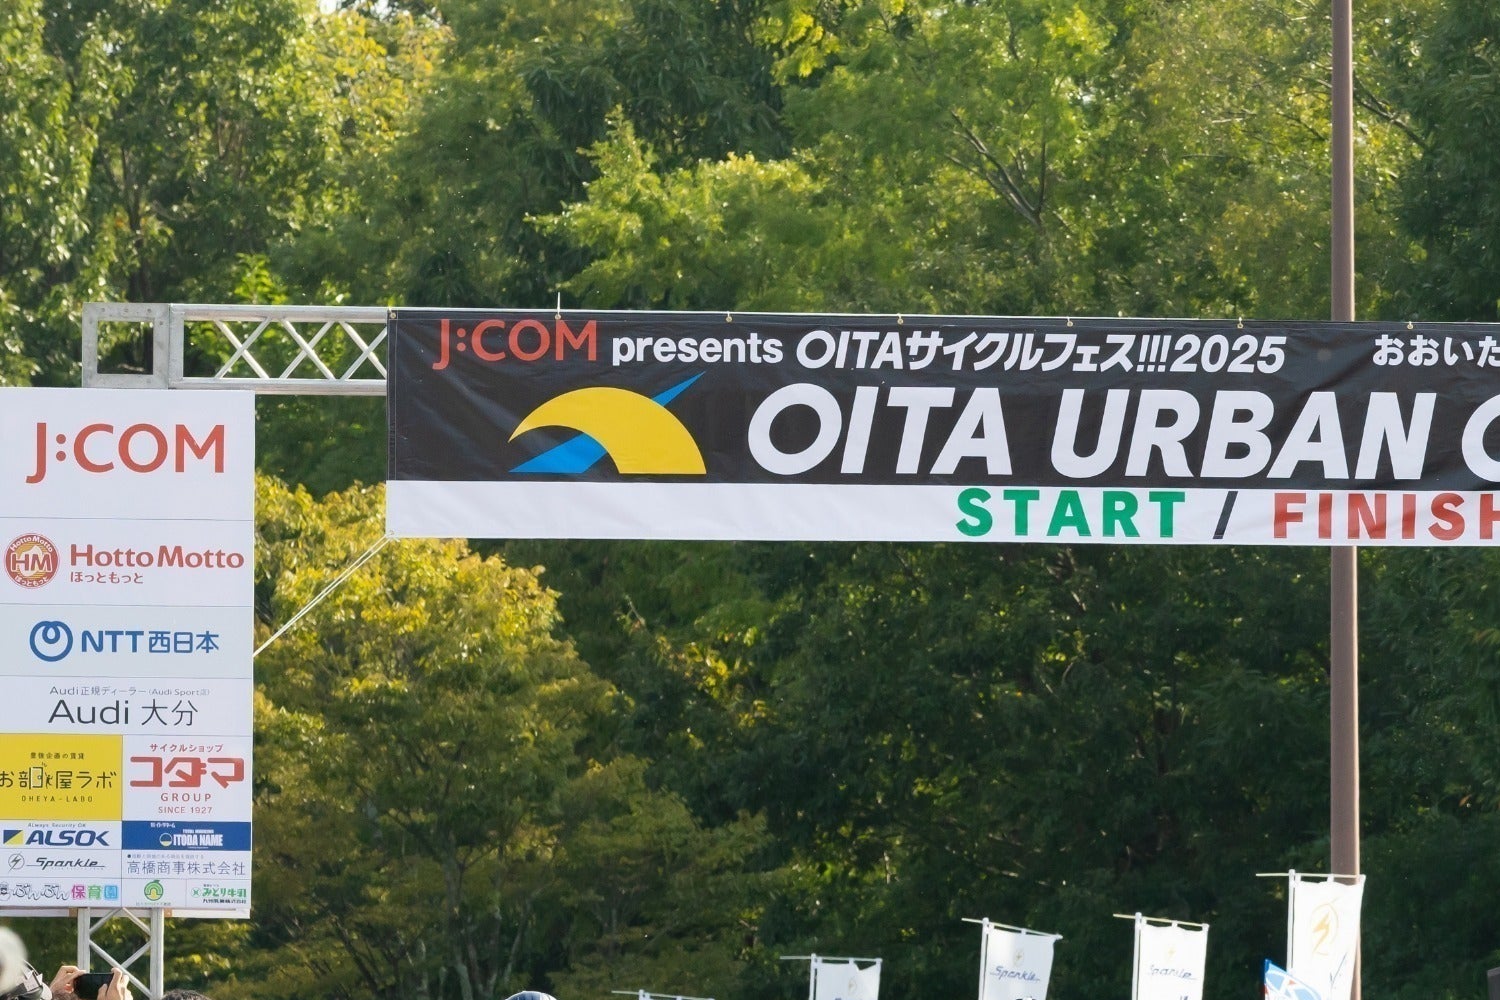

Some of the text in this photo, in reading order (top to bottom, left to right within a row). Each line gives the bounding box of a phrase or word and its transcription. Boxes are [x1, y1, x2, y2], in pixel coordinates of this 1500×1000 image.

[432, 318, 1287, 375] J:COM presents OITAサイクルフェス!!!2025
[747, 382, 1014, 477] OITA
[1050, 388, 1437, 482] URBAN
[26, 422, 225, 484] J:COM
[956, 486, 1187, 540] START
[70, 571, 144, 584] ほっともっと
[81, 630, 220, 654] NTT西日本
[48, 698, 199, 726] Audi 大分
[150, 743, 224, 753] サイクルショップ
[130, 756, 245, 789] コダマ
[160, 793, 212, 802] GROUP
[127, 861, 245, 875] 高橋商事株式会社
